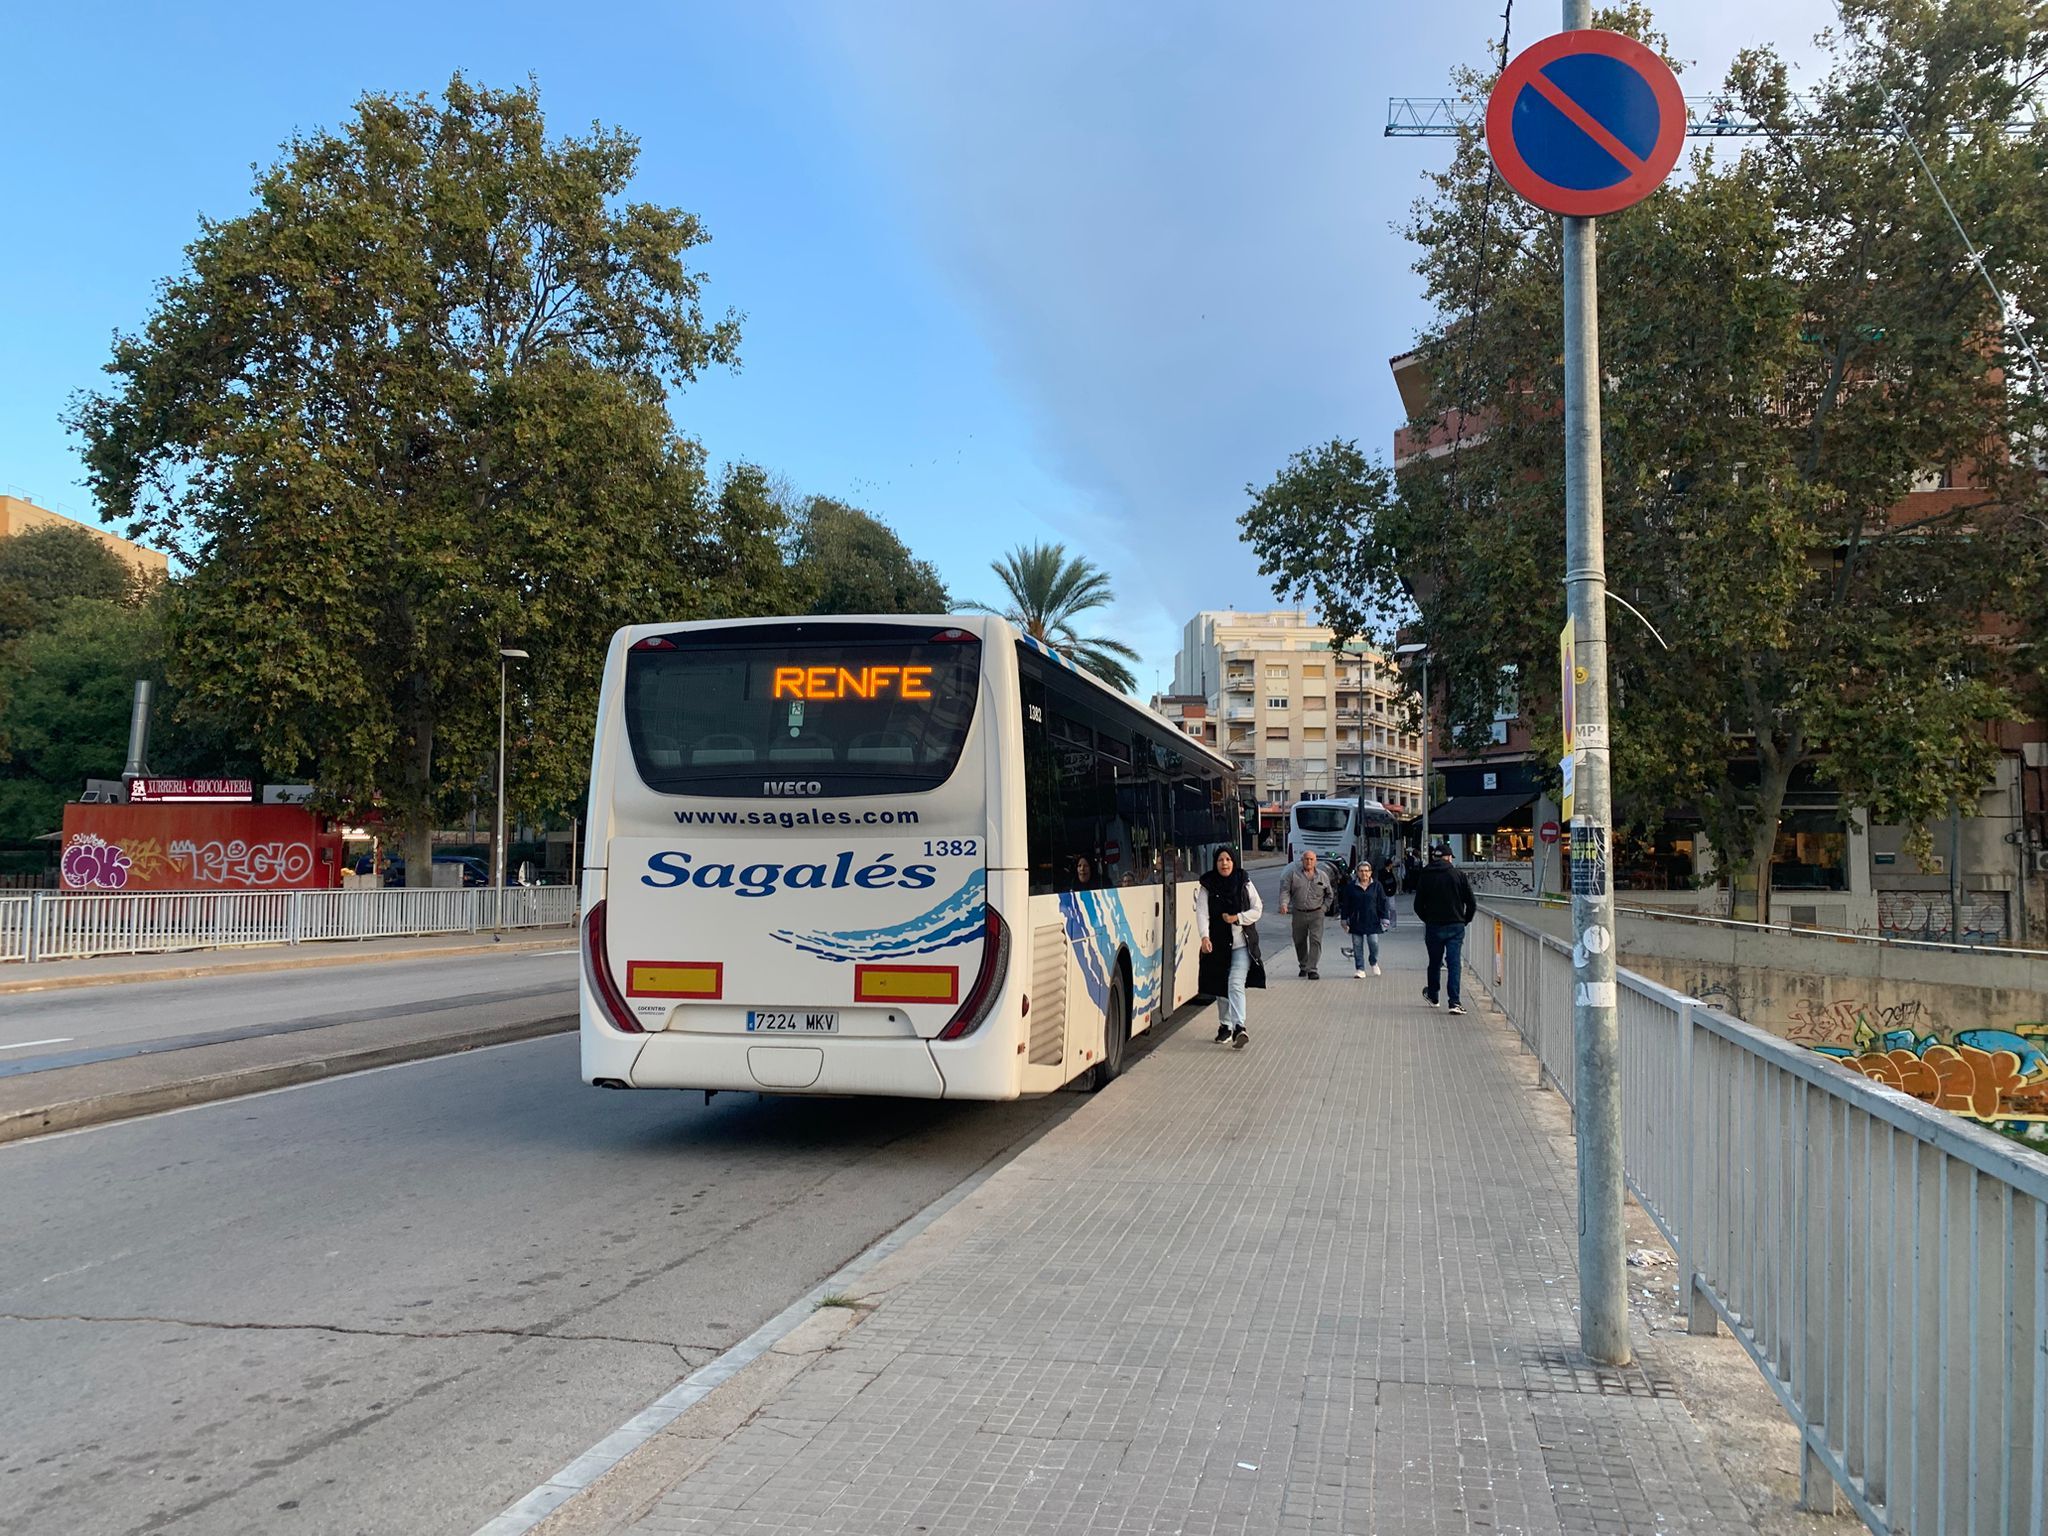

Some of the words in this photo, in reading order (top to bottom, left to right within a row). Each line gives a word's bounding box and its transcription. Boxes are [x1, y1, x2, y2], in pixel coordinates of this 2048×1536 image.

[773, 666, 933, 700] RENFE
[1028, 703, 1042, 724] 1382
[147, 780, 187, 793] XURRERIA
[763, 780, 822, 796] IVECO
[673, 808, 919, 828] www.sagales.com
[923, 839, 977, 857] 1382
[640, 850, 937, 897] Sagalés
[756, 1013, 796, 1030] 7224
[806, 1014, 834, 1031] MKV
